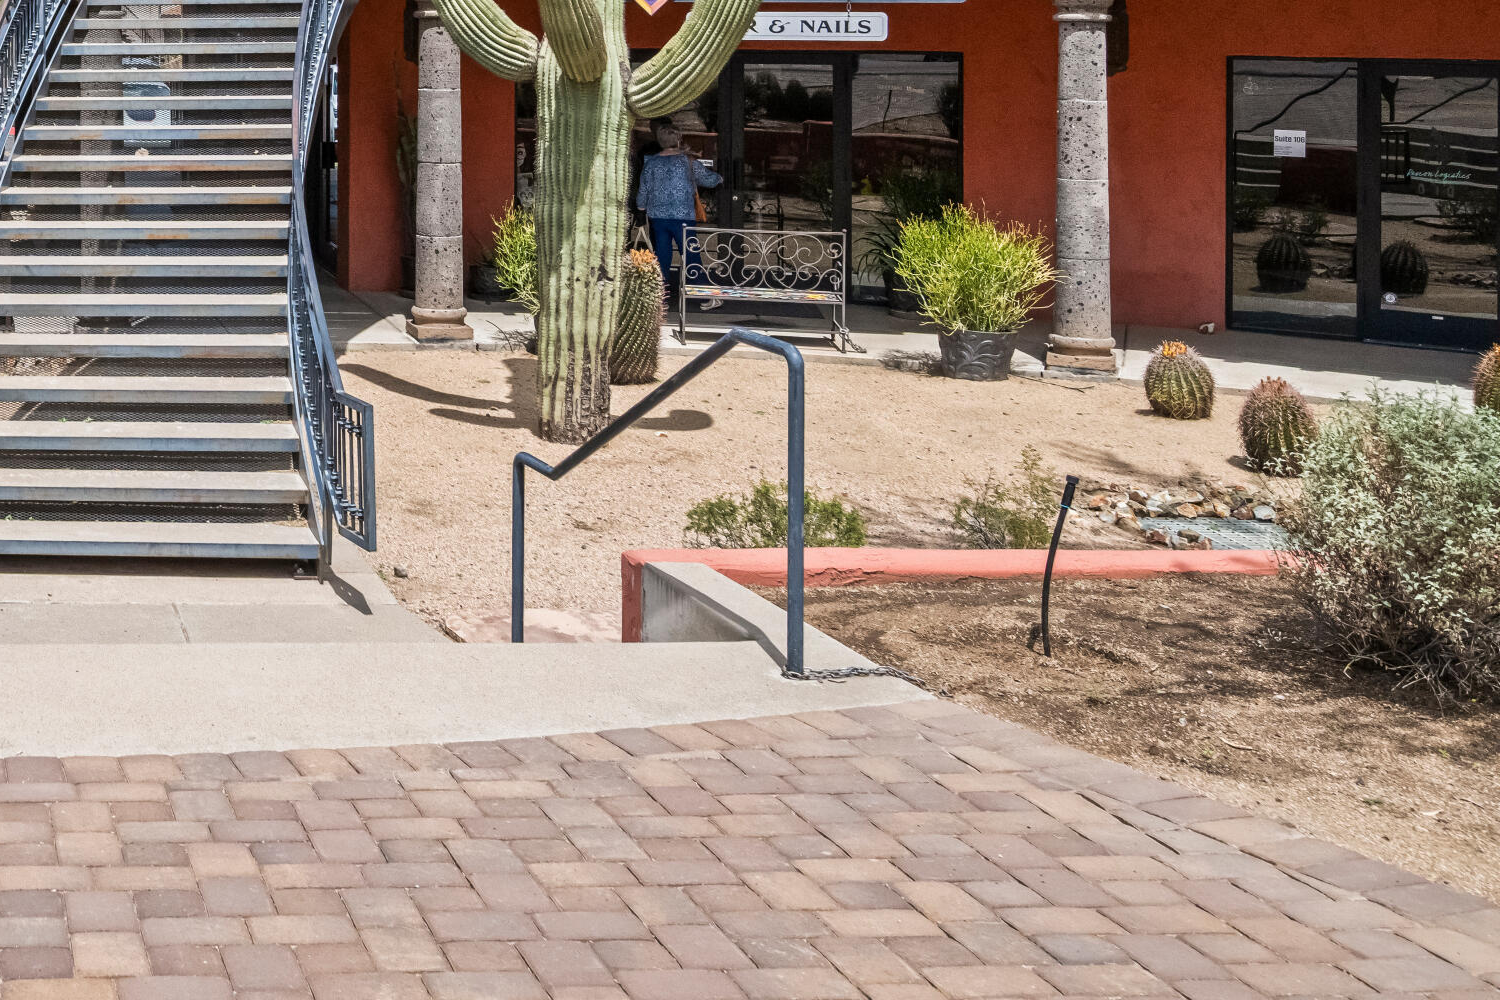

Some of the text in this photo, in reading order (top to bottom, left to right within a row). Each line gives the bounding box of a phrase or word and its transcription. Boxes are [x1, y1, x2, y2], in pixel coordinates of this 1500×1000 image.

[768, 19, 790, 34] &
[800, 19, 871, 34] NAILS
[1274, 135, 1292, 143] Suite
